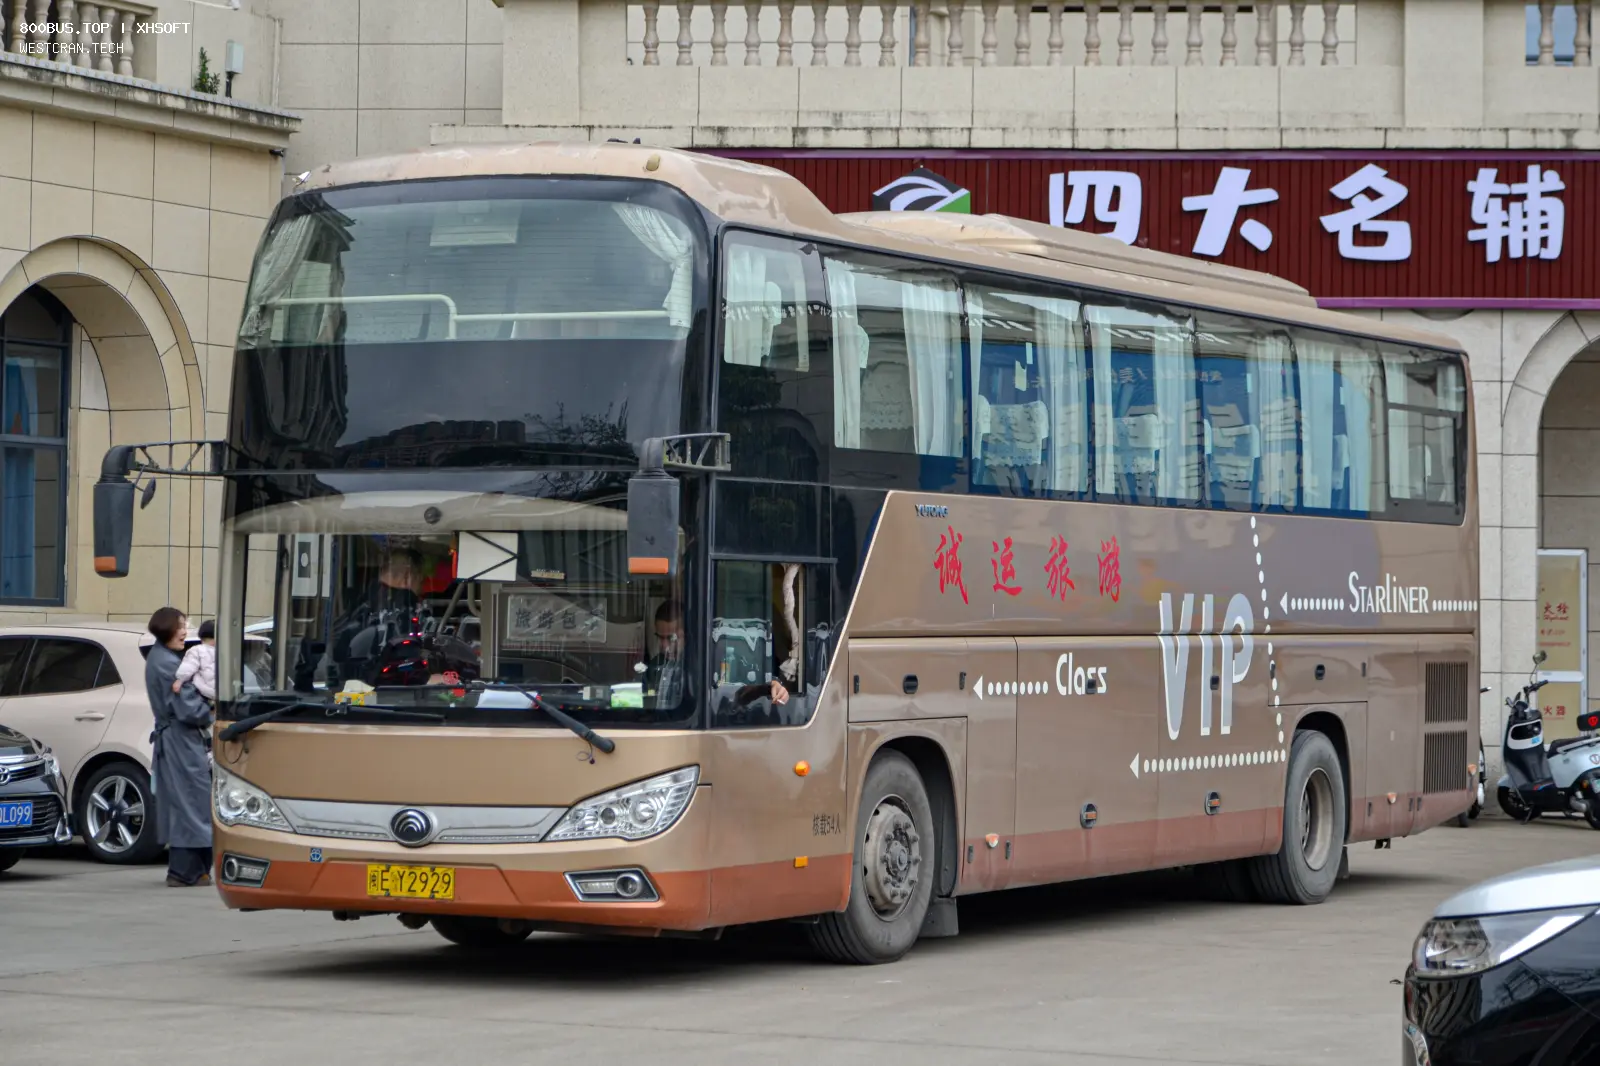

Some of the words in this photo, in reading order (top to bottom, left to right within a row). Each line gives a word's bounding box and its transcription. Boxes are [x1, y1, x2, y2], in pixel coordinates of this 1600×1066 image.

[1049, 163, 1566, 262] 四大名辅
[1158, 592, 1254, 740] VIP
